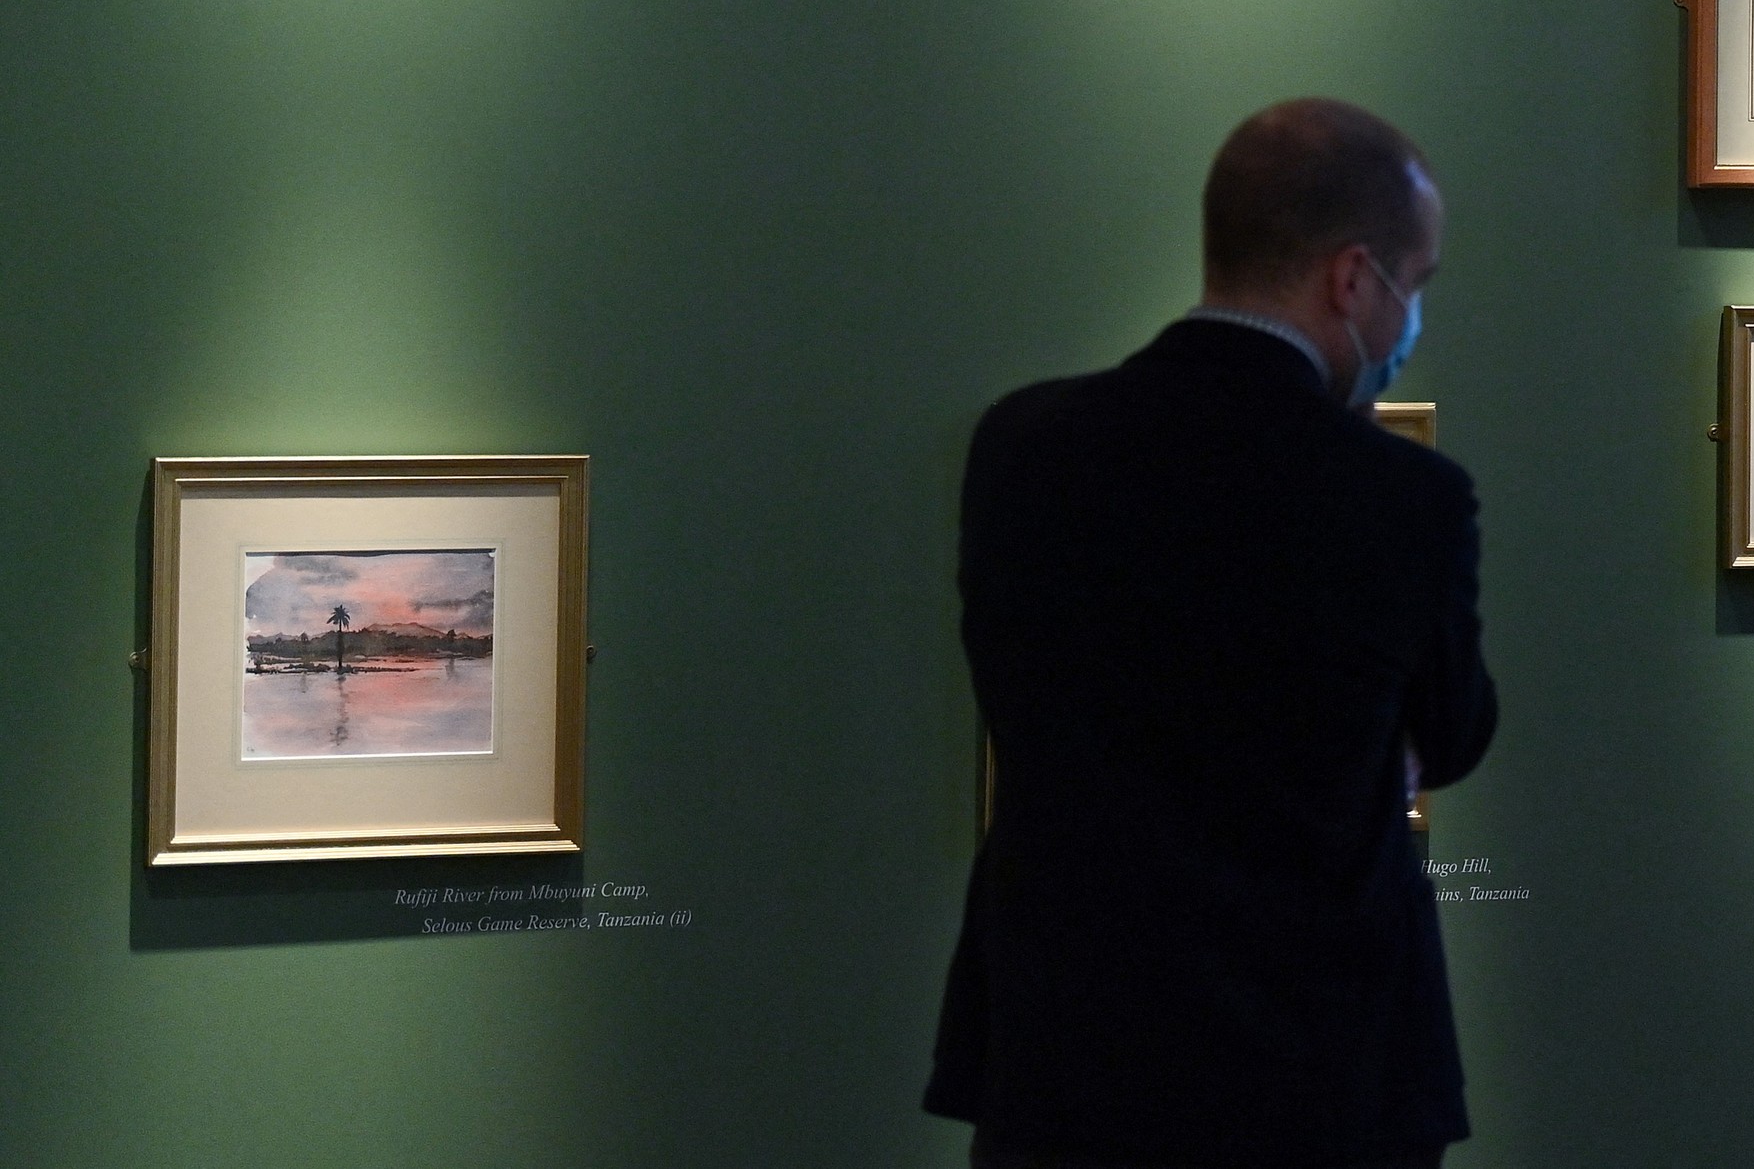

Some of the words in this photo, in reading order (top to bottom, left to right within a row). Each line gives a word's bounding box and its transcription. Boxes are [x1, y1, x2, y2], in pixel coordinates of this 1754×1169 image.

[1421, 859, 1458, 877] Hugo
[1461, 858, 1492, 875] Hill,
[394, 888, 438, 909] Rufiji
[442, 887, 484, 904] River
[485, 886, 523, 906] from
[528, 883, 597, 904] Mbuyuni
[600, 881, 650, 901] Camp,
[1469, 886, 1530, 901] Tanzania
[421, 917, 473, 934] Selous
[477, 916, 523, 932] Game
[527, 914, 591, 931] Reserve,
[597, 911, 665, 928] Tanzania
[669, 909, 693, 928] (ii)
